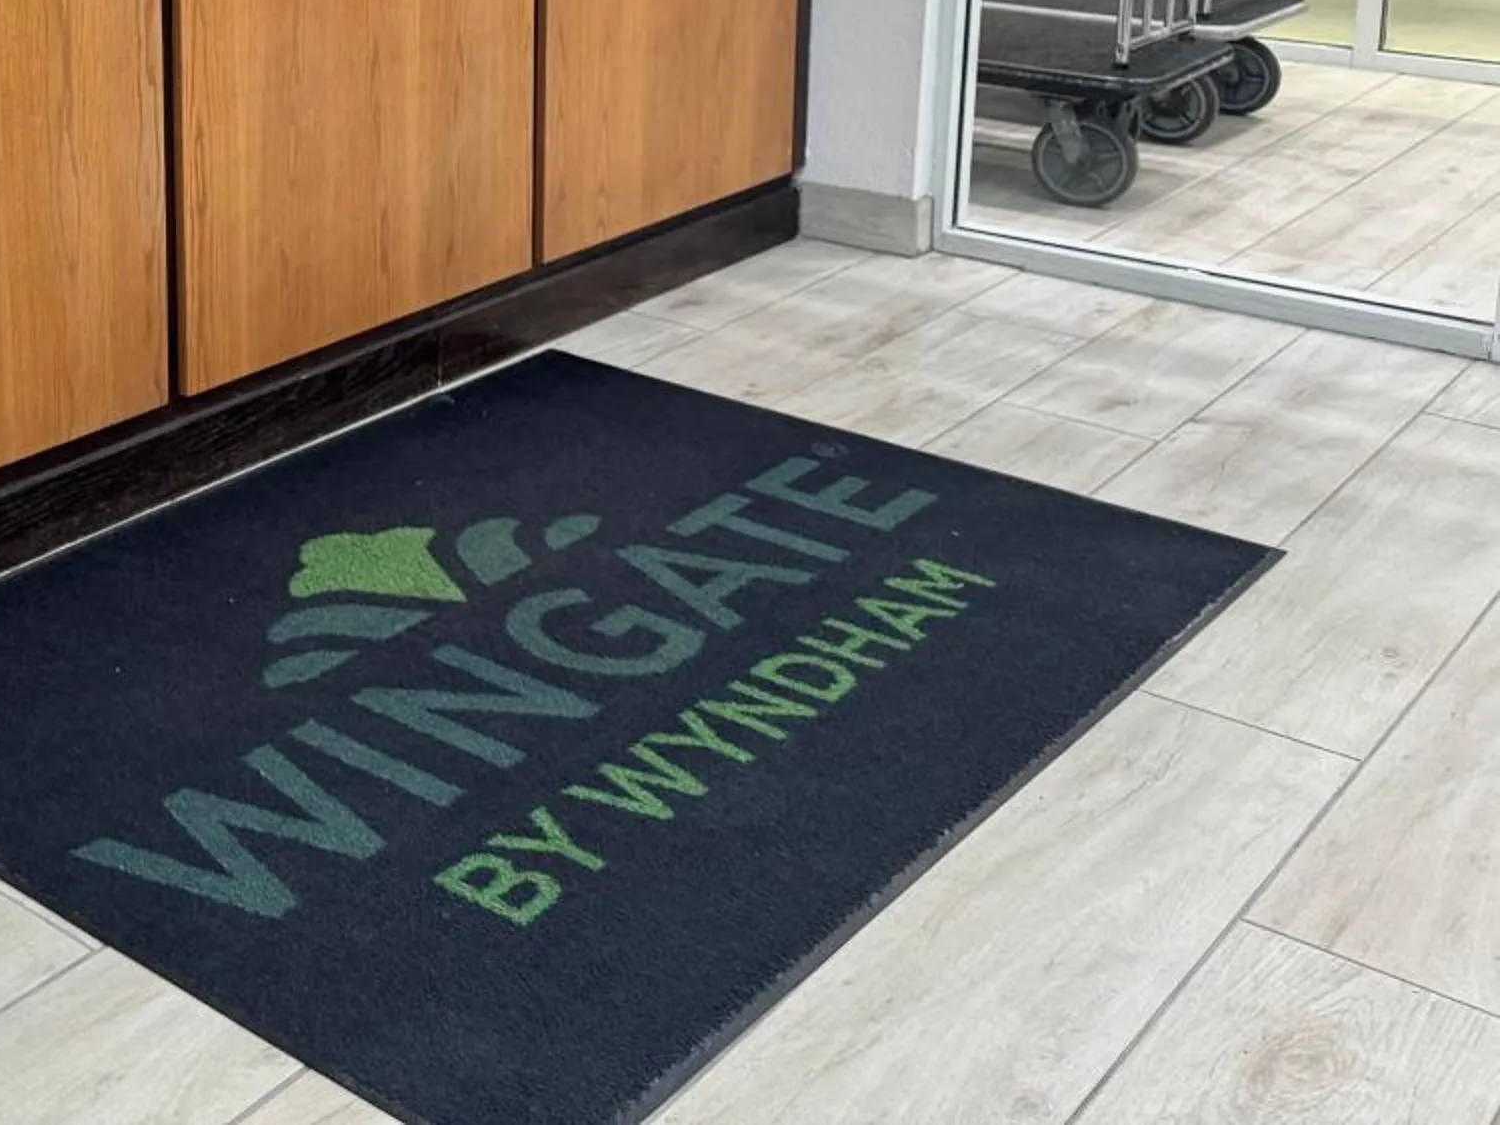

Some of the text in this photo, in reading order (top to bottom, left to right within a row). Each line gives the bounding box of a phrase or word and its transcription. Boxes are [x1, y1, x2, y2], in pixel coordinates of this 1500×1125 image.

[69, 456, 938, 920] WINGATE
[433, 558, 998, 927] BY WYNDHAM
